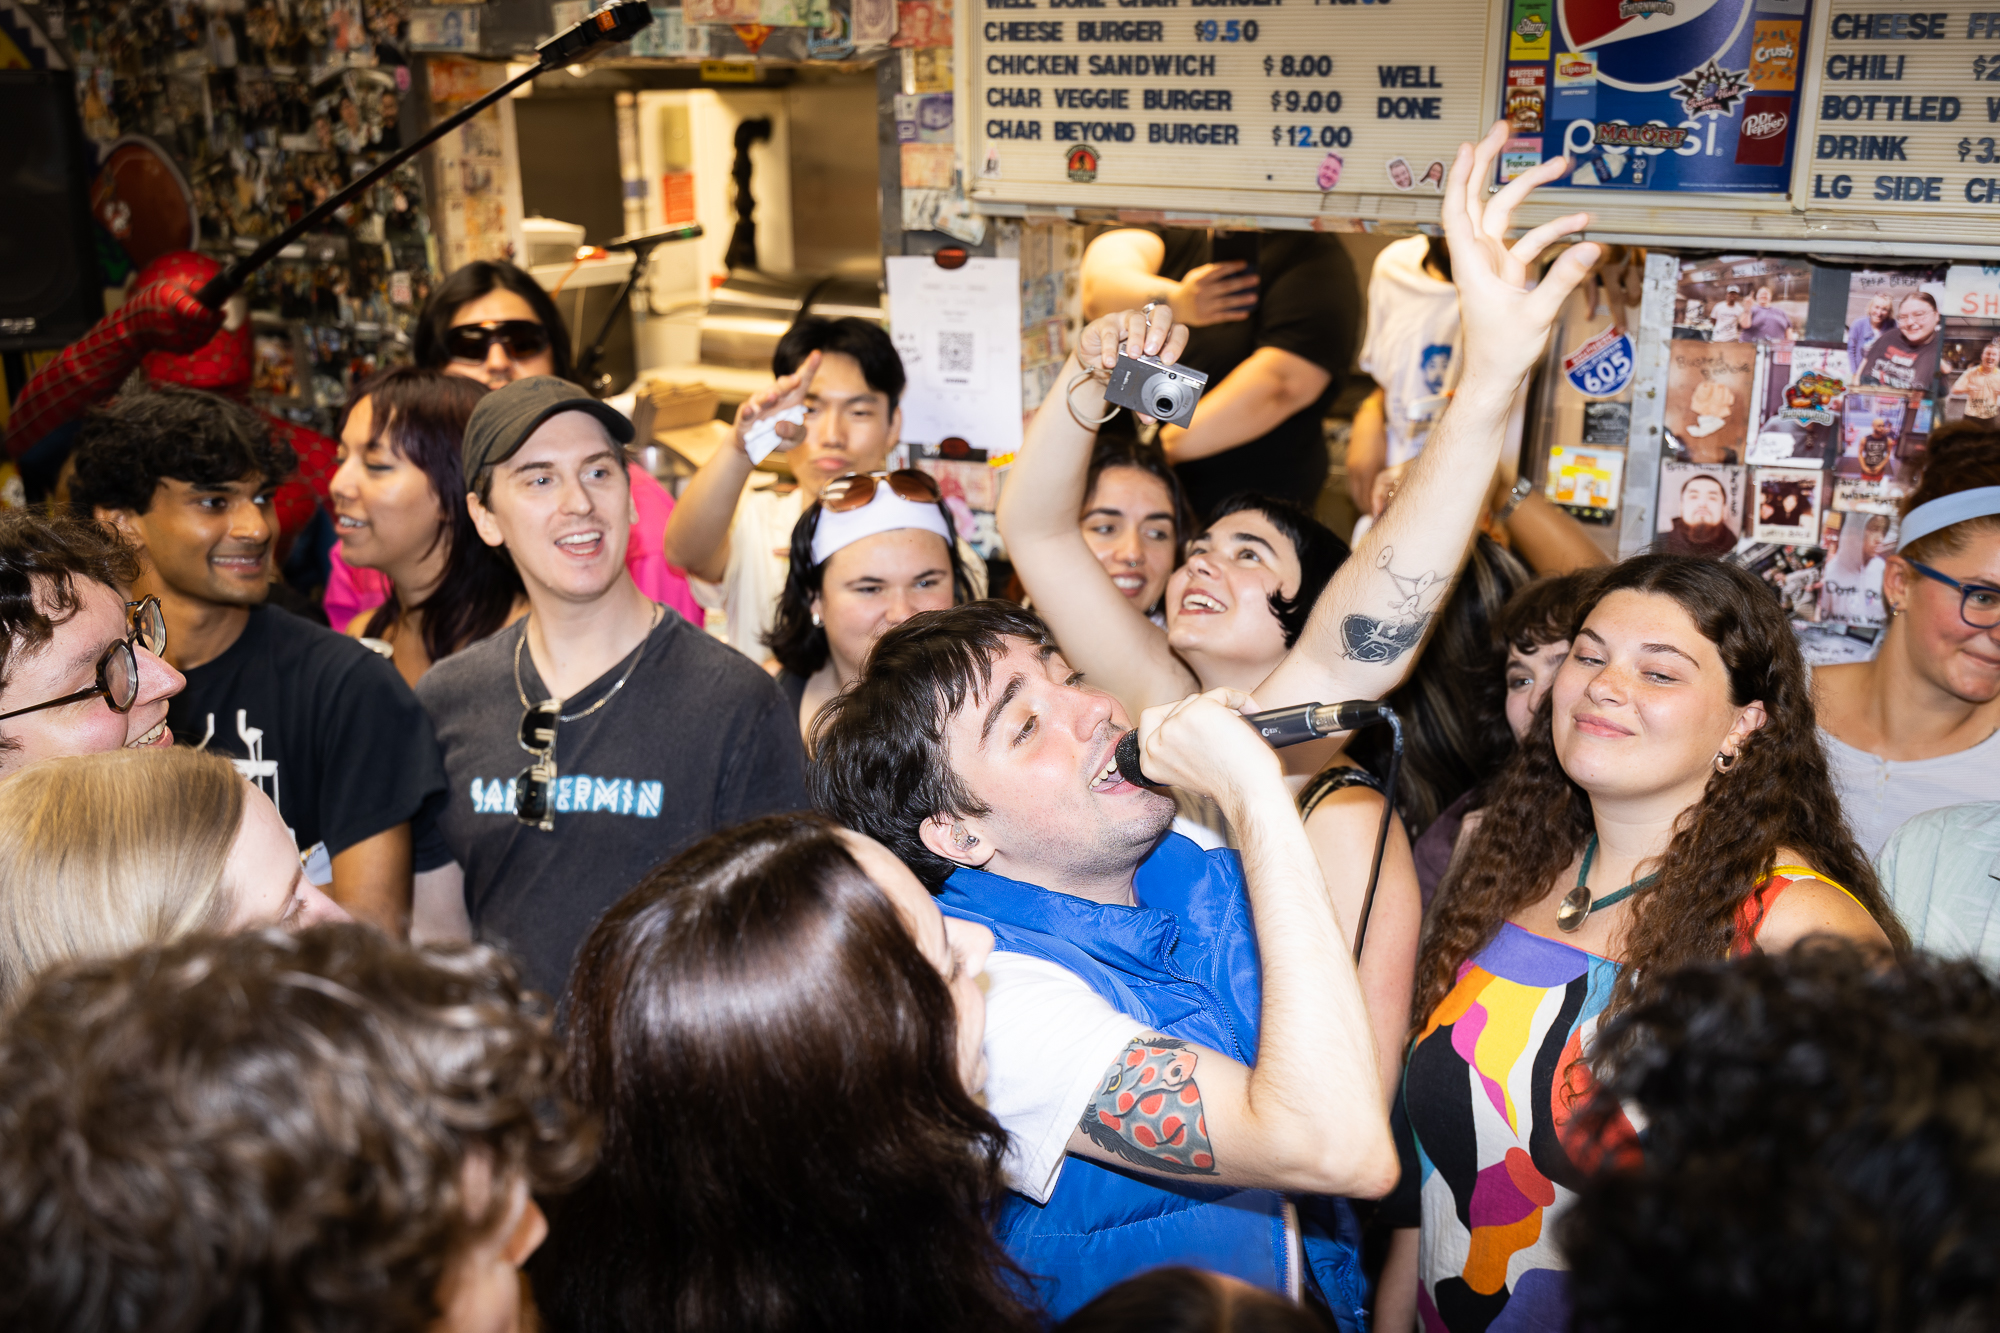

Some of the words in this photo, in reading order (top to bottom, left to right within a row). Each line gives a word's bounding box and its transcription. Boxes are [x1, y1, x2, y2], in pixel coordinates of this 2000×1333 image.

[985, 21, 1063, 41] CHEESE
[1078, 21, 1163, 41] BURGER
[1194, 20, 1259, 42] $9.50
[1516, 16, 1547, 38] Starry
[1831, 13, 1947, 40] CHEESE
[1754, 44, 1795, 63] Crush
[987, 55, 1079, 75] CHICKEN
[1088, 55, 1216, 76] SANDWICH
[1263, 55, 1332, 77] $8.00
[1378, 65, 1442, 88] WELL
[1509, 69, 1545, 78] CAFFEINE
[1561, 65, 1592, 76] Lipton
[1826, 55, 1905, 80] CHILI
[1516, 78, 1536, 87] FREE
[986, 88, 1042, 108] CHAR
[1054, 89, 1129, 109] VEGGIE
[1143, 90, 1232, 111] BURGER
[1271, 90, 1342, 113] $9.00
[1377, 97, 1441, 119] DONE
[1510, 96, 1541, 113] MUG
[1821, 95, 1961, 122] BOTTLED
[1746, 115, 1785, 137] Pepper
[1760, 112, 1776, 122] Dr
[986, 120, 1042, 140] CHAR
[1054, 121, 1136, 142] BEYOND
[1148, 123, 1239, 145] BURGER
[1272, 125, 1352, 148] $12.00
[1600, 124, 1686, 144] MALÖRT
[1816, 135, 1909, 161] DRINK
[1505, 159, 1537, 168] Tropicana
[1632, 158, 1647, 170] 20
[1814, 174, 1853, 199] LG
[1874, 176, 1943, 201] SIDE
[1584, 350, 1631, 393] 605
[551, 775, 664, 817] ERMIN
